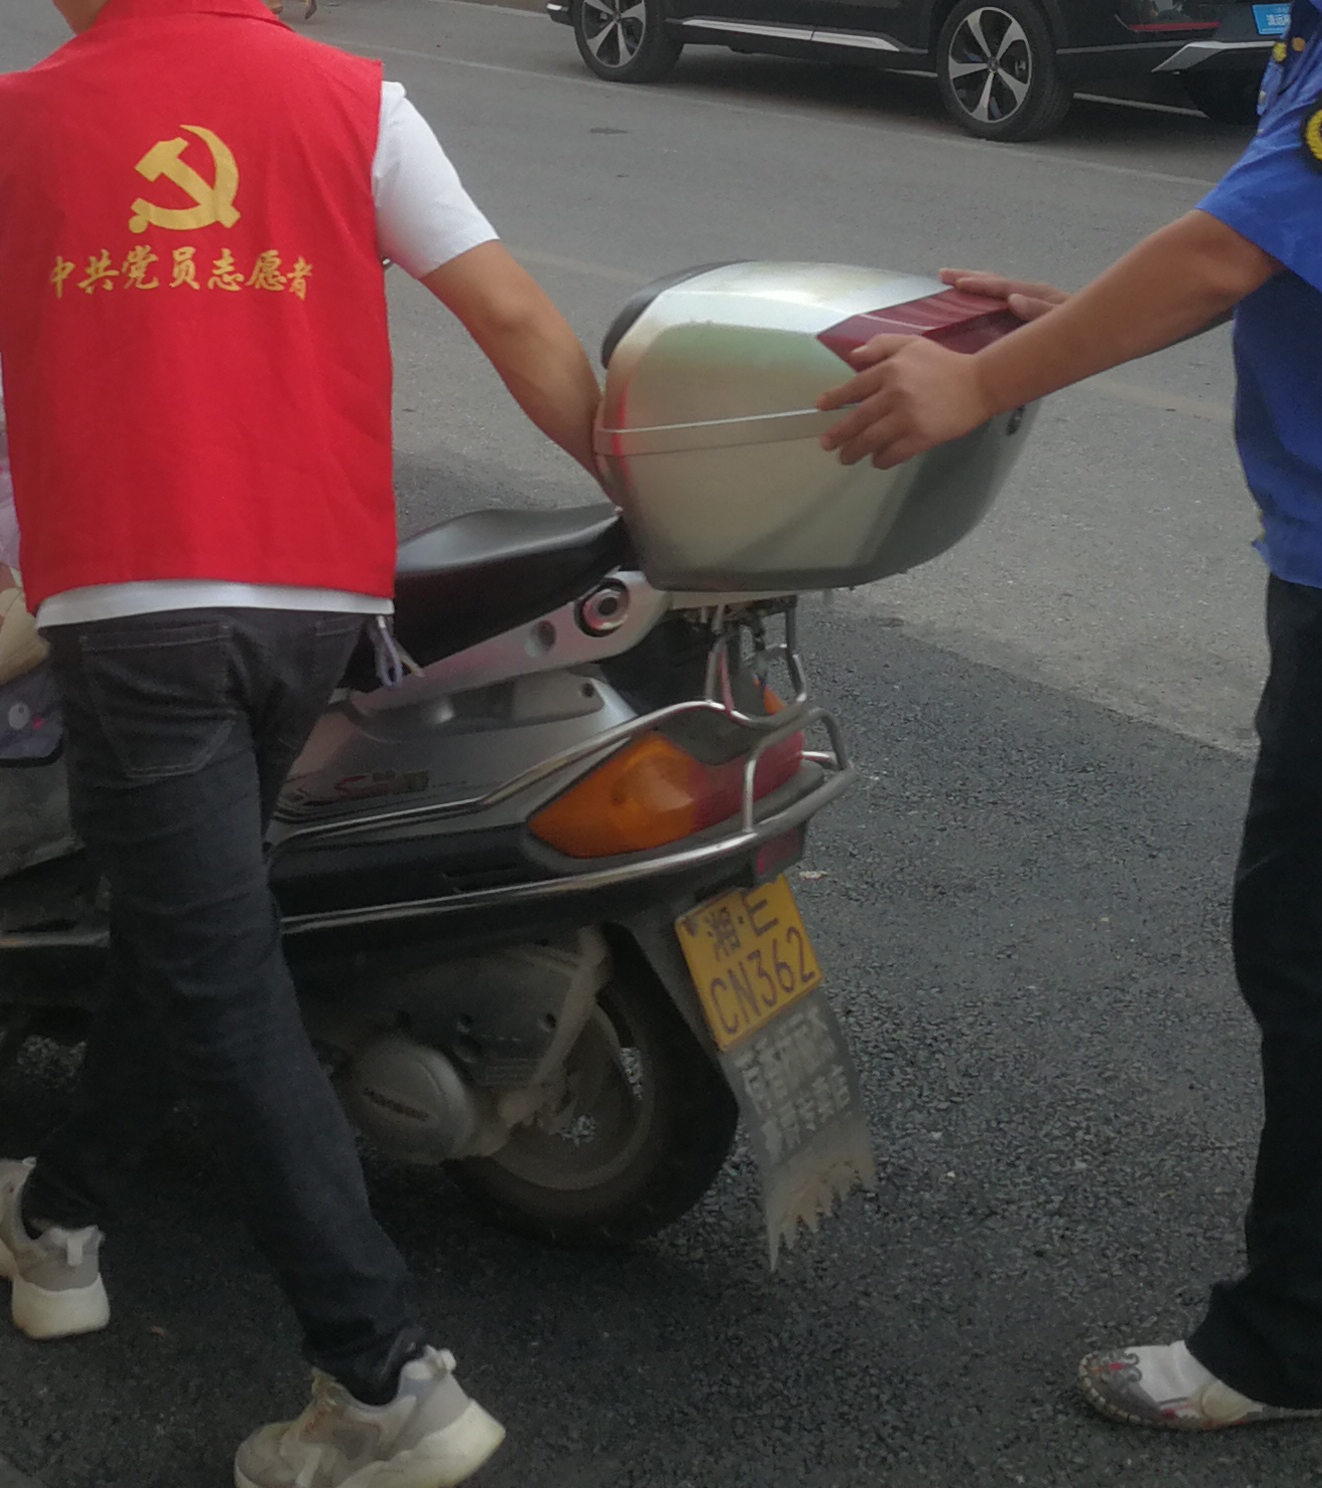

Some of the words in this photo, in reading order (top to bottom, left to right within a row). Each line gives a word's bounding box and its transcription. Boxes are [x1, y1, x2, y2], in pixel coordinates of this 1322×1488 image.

[49, 244, 314, 300] 中共党员志愿者
[709, 925, 816, 1036] CN362
